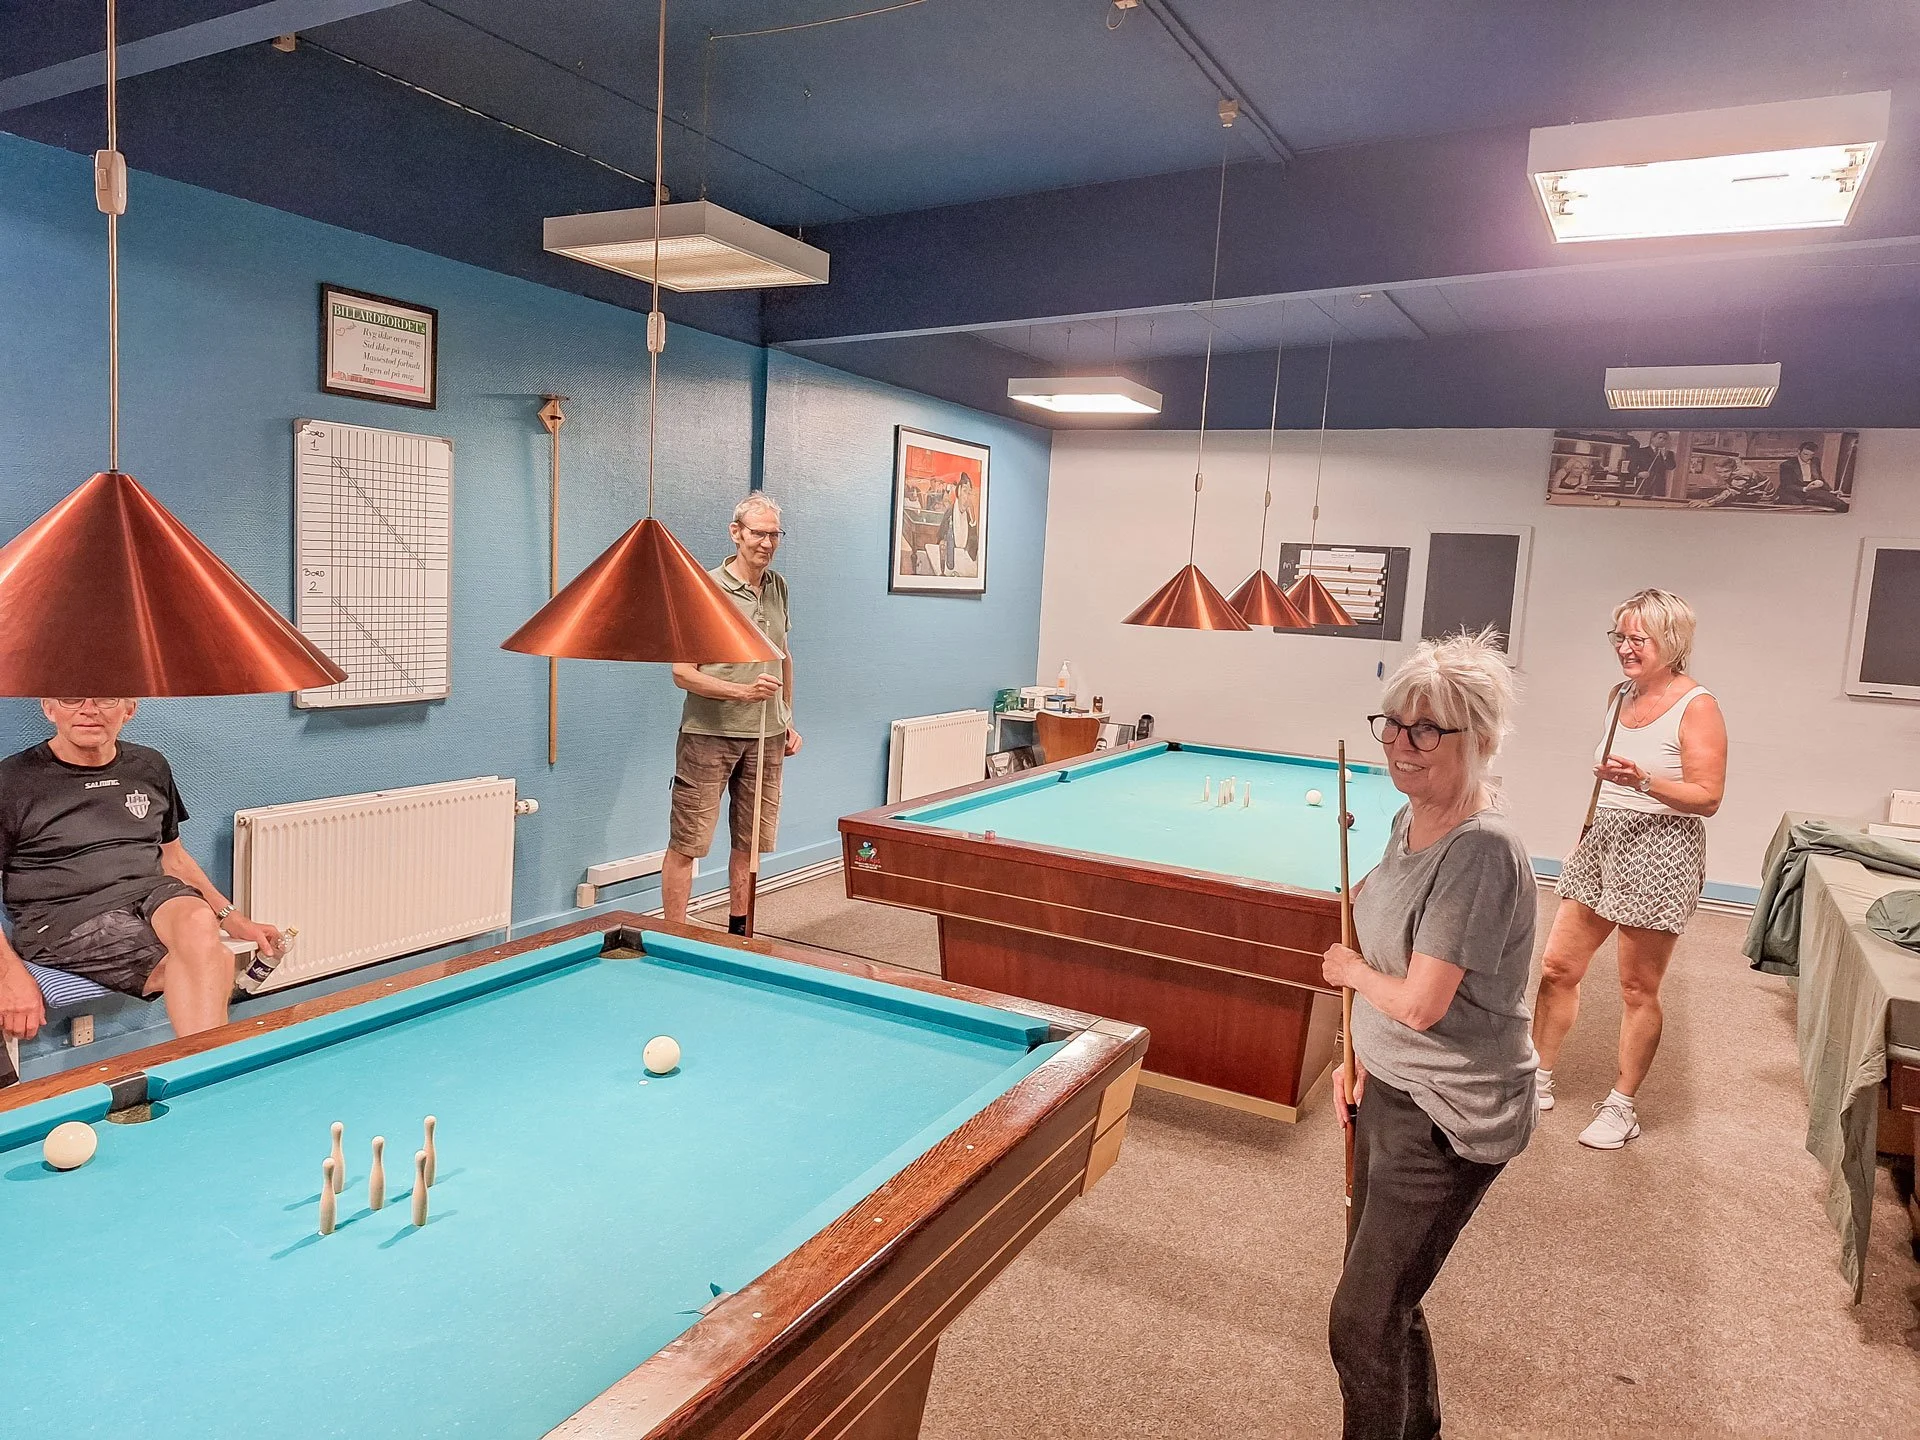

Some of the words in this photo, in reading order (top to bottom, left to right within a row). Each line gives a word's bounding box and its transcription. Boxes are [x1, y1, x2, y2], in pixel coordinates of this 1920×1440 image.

[363, 328, 377, 340] Ryg
[378, 331, 392, 340] ikke
[409, 340, 421, 348] mig
[363, 340, 375, 349] Sid
[376, 343, 390, 352] ikke
[402, 350, 414, 358] mig
[362, 364, 382, 374] Ingen
[402, 373, 414, 381] mig
[396, 359, 421, 370] forbudt
[309, 581, 317, 590] 2
